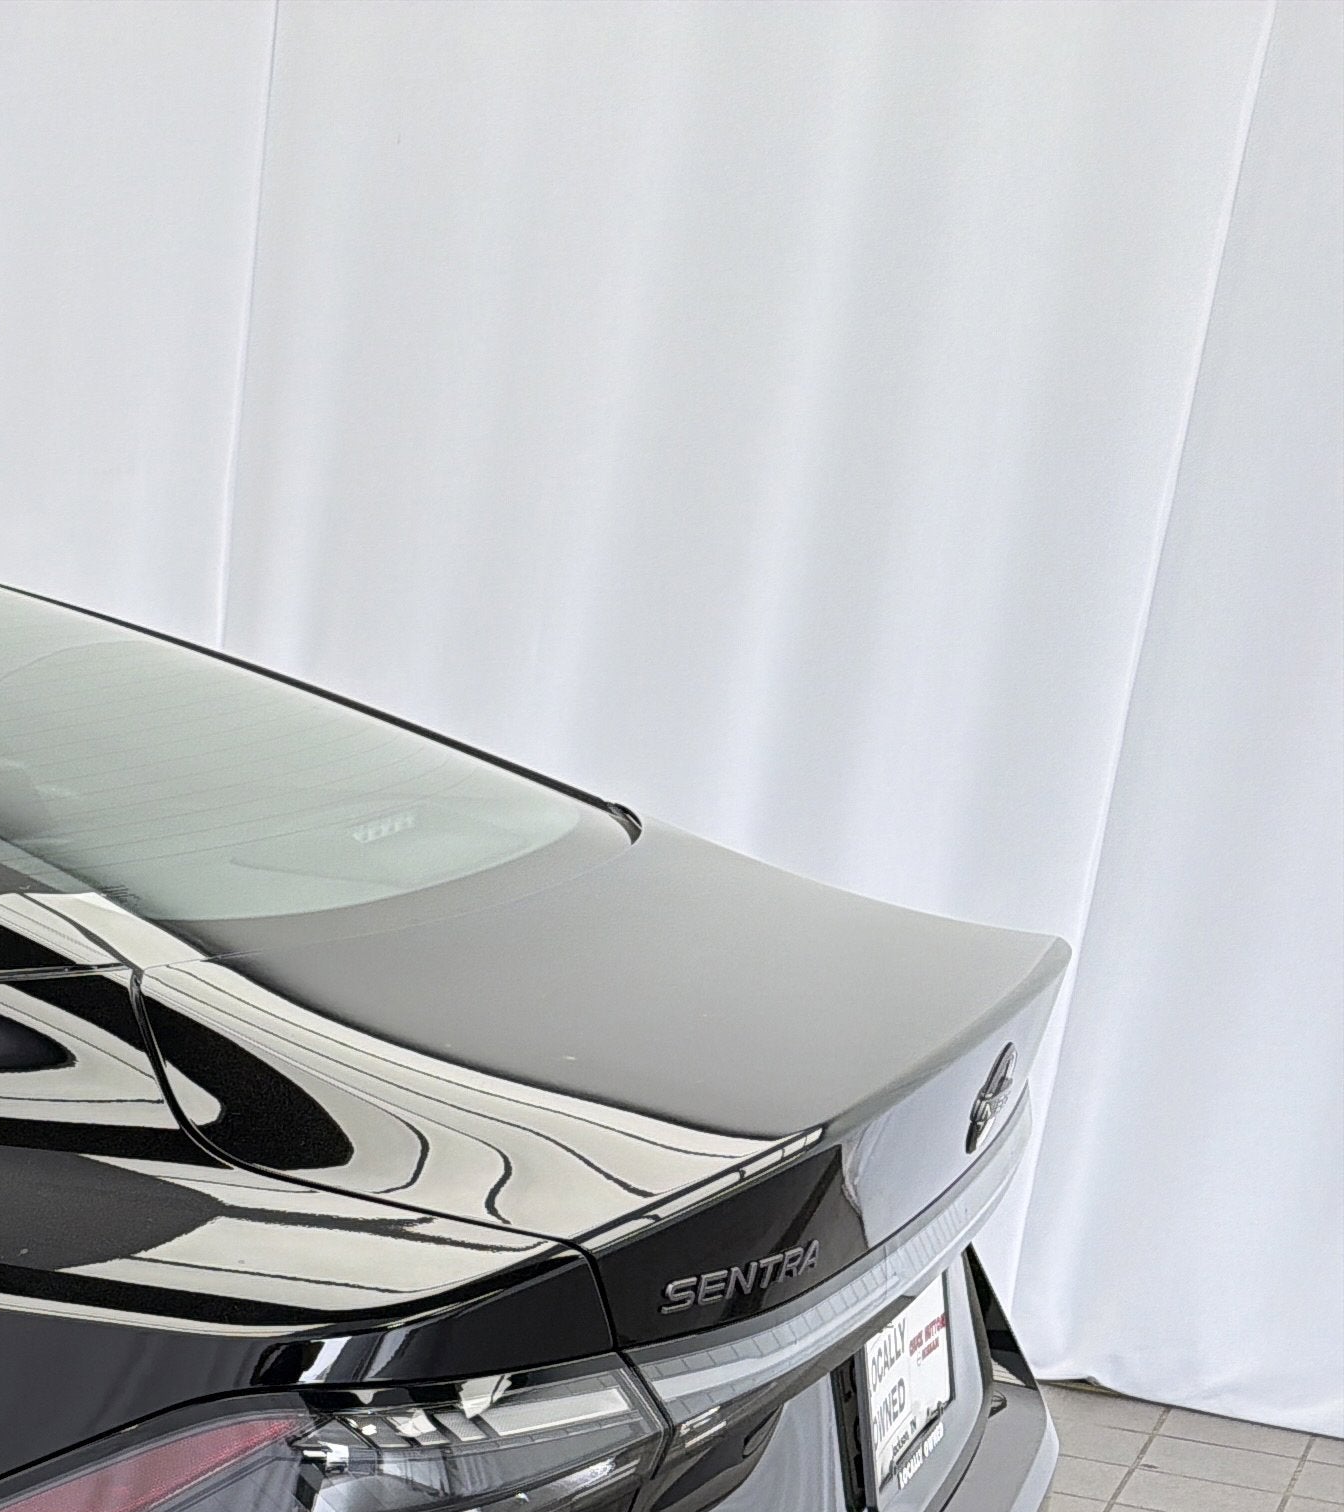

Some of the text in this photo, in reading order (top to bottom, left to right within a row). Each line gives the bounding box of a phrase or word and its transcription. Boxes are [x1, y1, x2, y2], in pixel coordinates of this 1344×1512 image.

[661, 1239, 820, 1314] SENTRA
[869, 1317, 906, 1397] OCALLY
[872, 1377, 906, 1452] OWNED
[897, 1421, 944, 1490] LOCALLY OWNED
